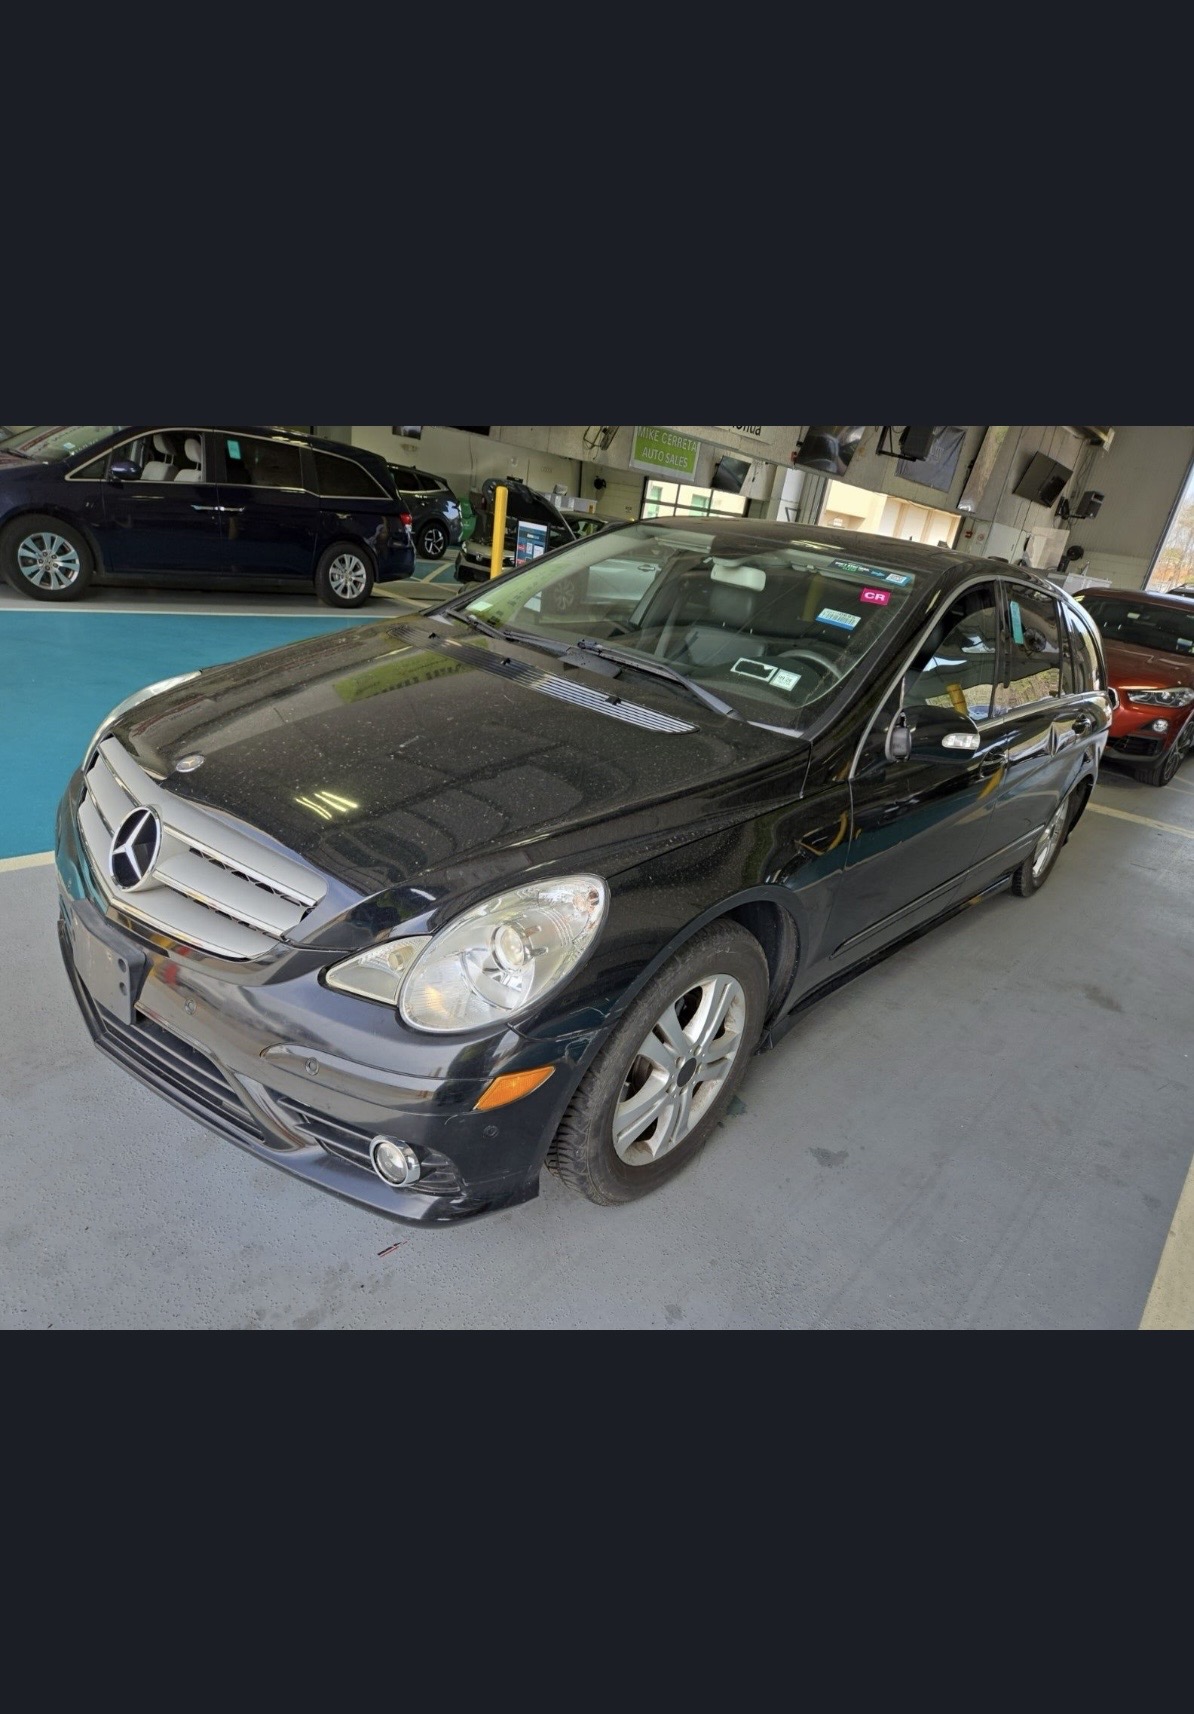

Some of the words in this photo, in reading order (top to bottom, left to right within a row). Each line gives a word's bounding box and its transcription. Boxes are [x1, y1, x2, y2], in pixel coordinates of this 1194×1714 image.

[637, 426, 660, 442] MIKE
[661, 432, 698, 452] CERRETA
[642, 446, 665, 462] AUTO
[665, 452, 689, 468] SALES
[864, 592, 886, 601] CR
